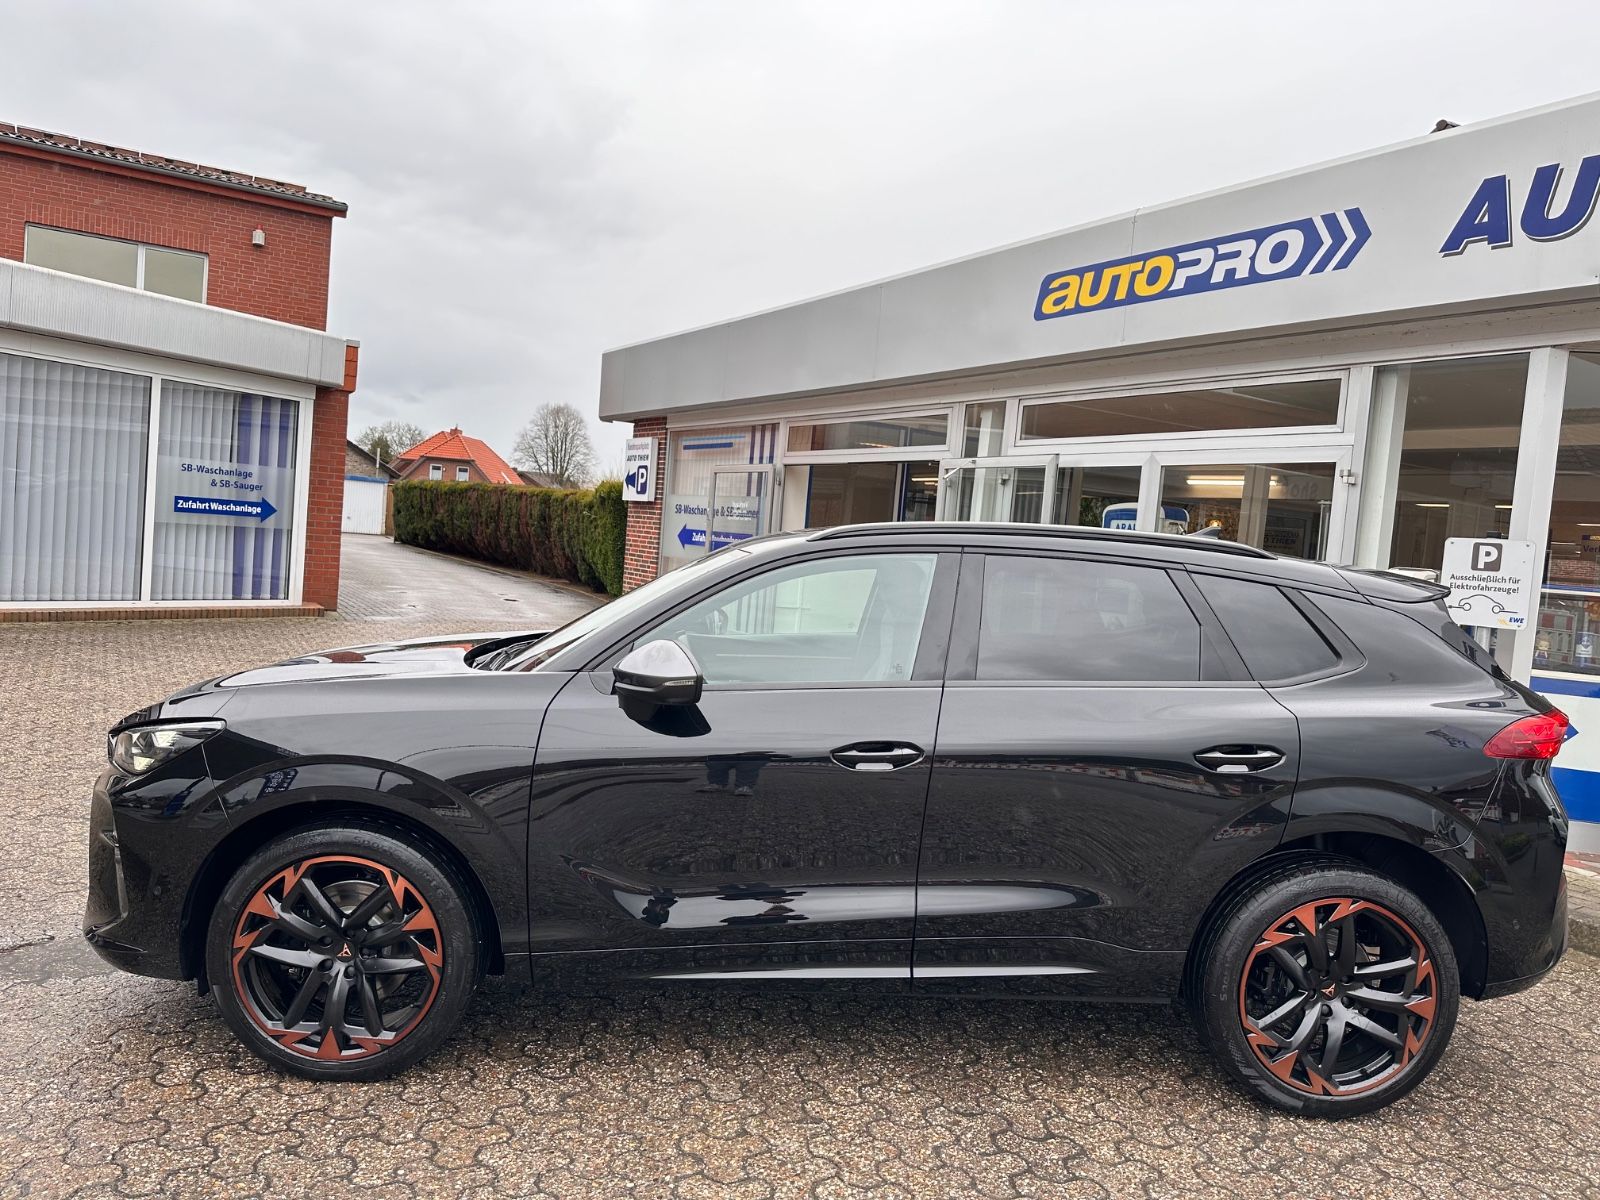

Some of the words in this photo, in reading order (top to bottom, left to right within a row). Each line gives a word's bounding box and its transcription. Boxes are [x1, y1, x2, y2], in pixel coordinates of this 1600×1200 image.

[181, 463, 253, 479] SB-Waschanlage
[210, 479, 218, 487] &
[220, 480, 263, 491] SB-Sauger
[638, 468, 647, 491] P
[177, 499, 210, 510] Zufahrt
[210, 502, 261, 514] Waschanlage
[720, 506, 726, 517] &
[1477, 545, 1499, 569] P
[1450, 573, 1507, 584] Ausschließlich
[1508, 575, 1521, 584] für
[1450, 582, 1519, 594] Elektrofahrzeuge!
[1509, 616, 1525, 624] EWE
